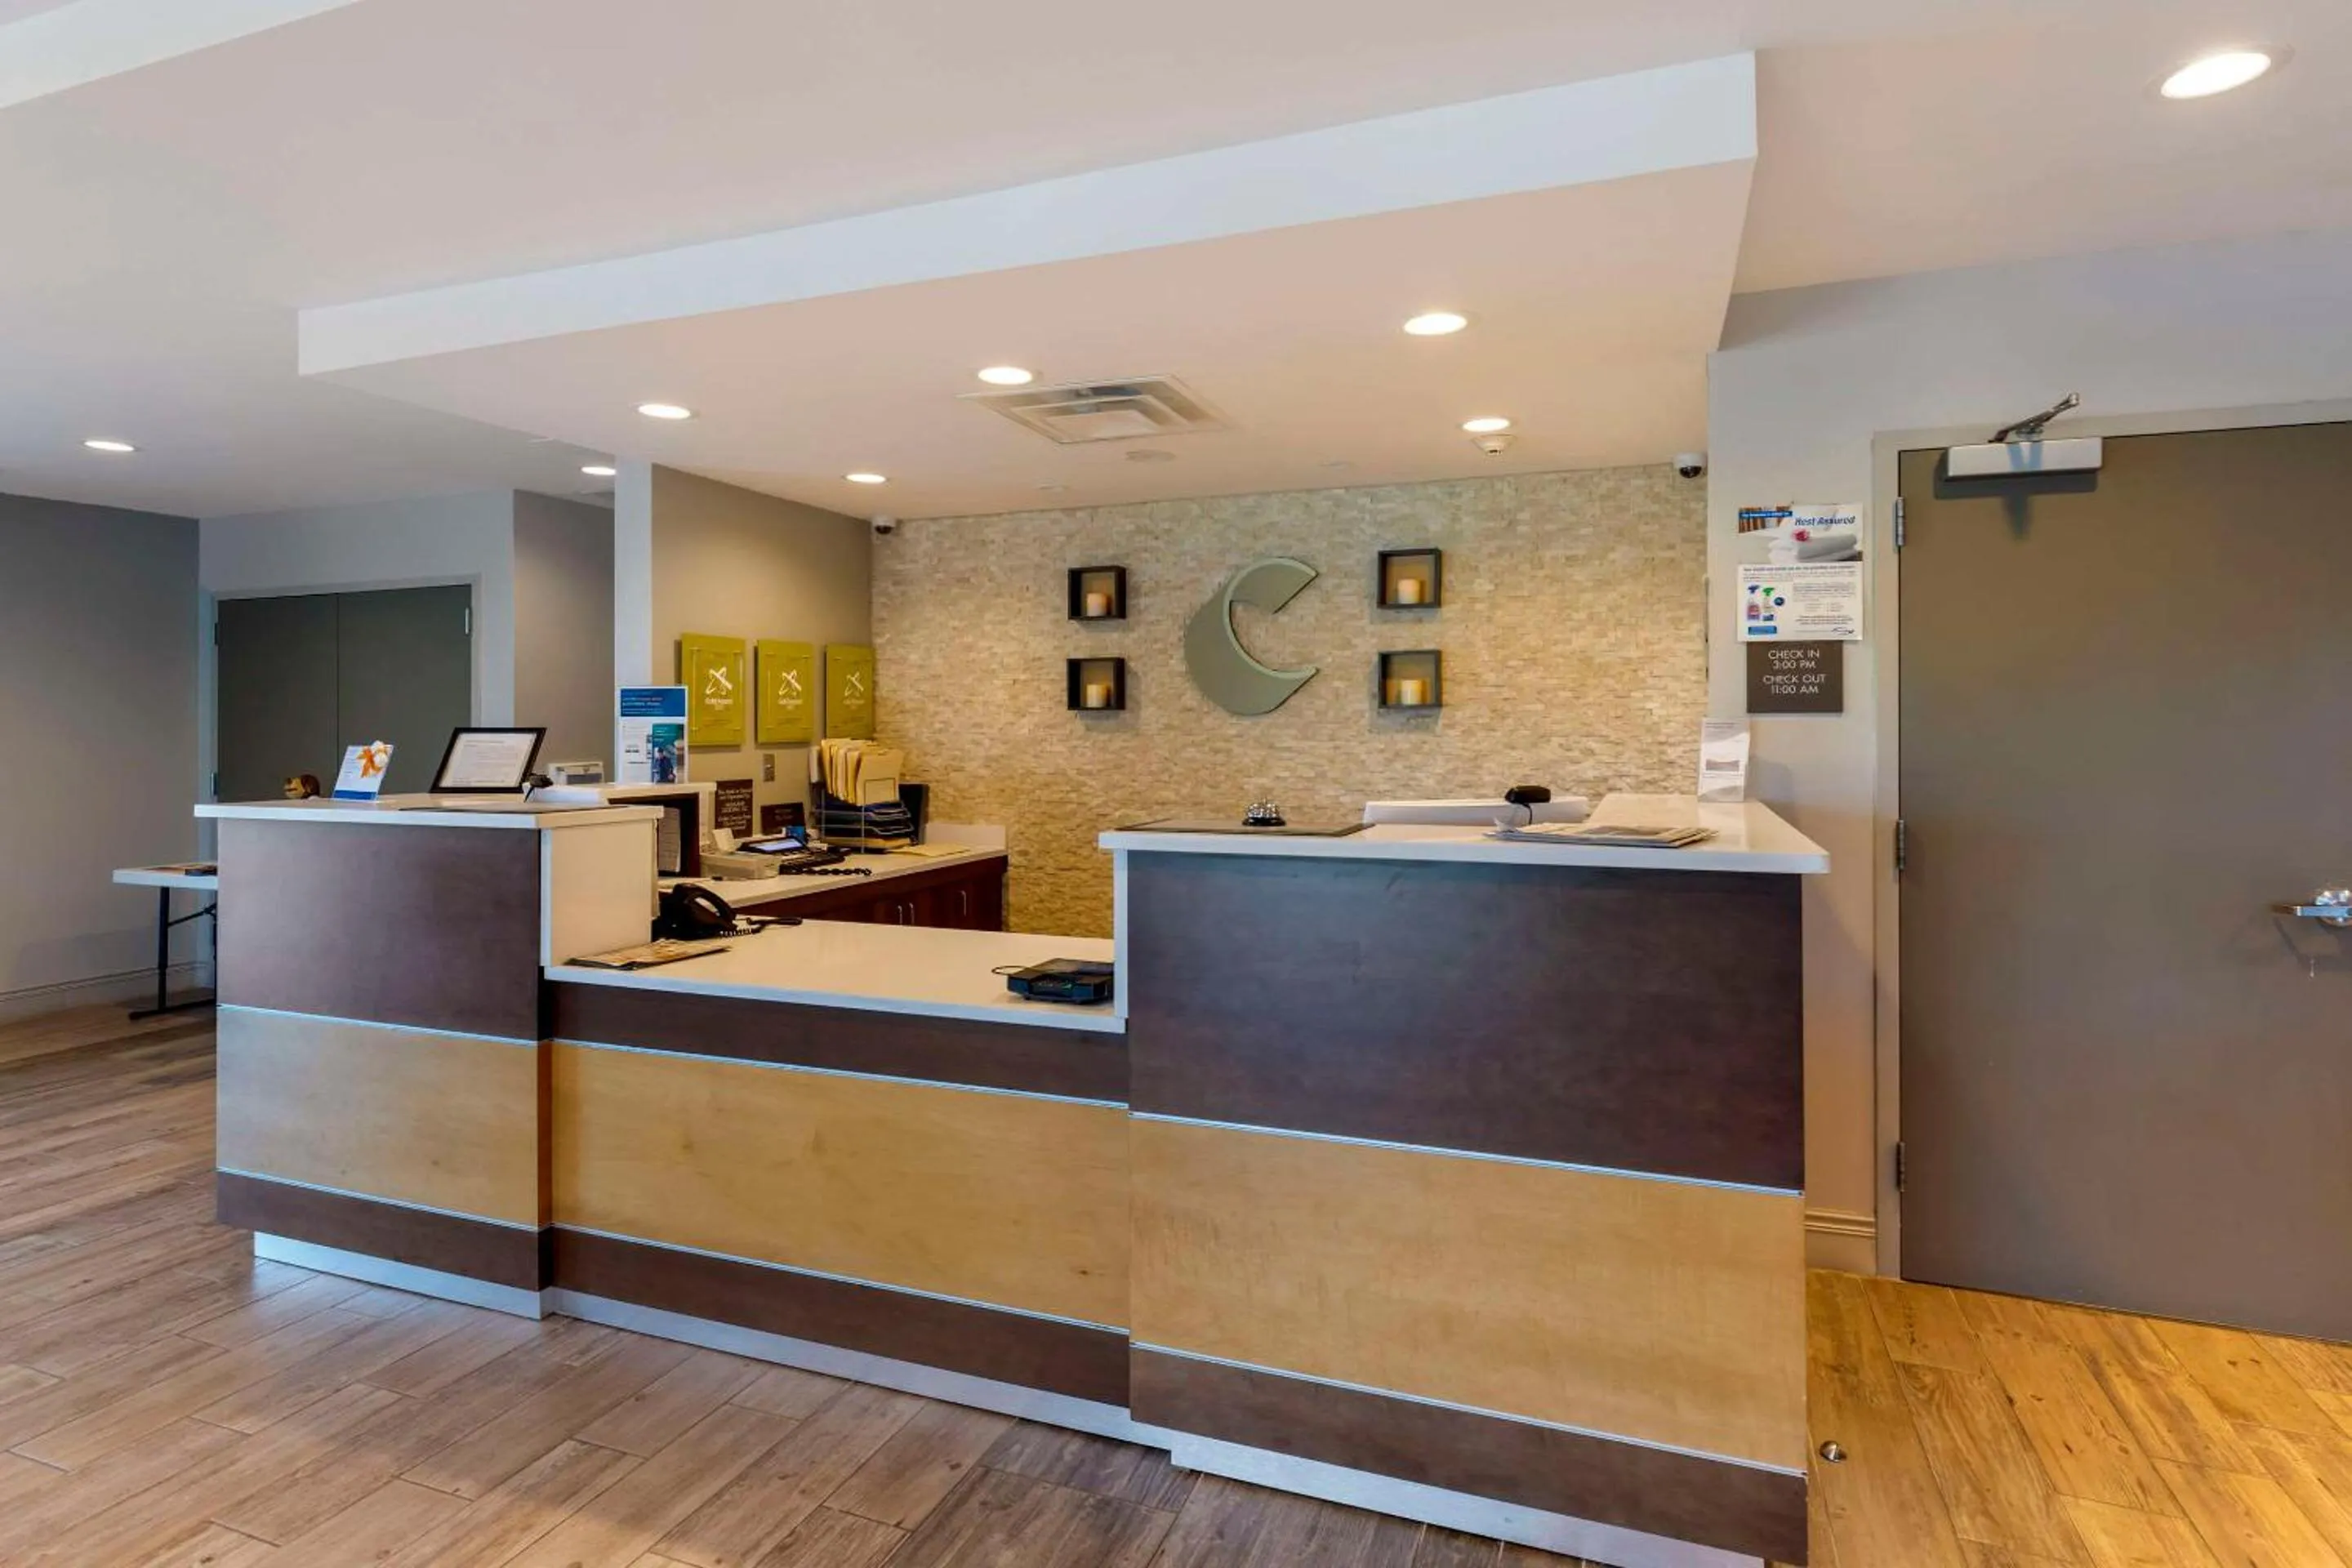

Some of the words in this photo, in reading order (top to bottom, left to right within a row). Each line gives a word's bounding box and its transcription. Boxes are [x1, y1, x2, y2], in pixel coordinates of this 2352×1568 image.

[1794, 516, 1815, 526] Rest
[1817, 515, 1856, 525] Assured
[1768, 649, 1804, 659] CHECK
[1807, 648, 1820, 658] IN
[1773, 660, 1797, 670] 3:00
[1799, 660, 1816, 669] PM
[1763, 675, 1799, 684] CHECK
[1802, 674, 1826, 684] OUT
[1771, 685, 1797, 694] 11:00
[1799, 685, 1819, 694] AM
